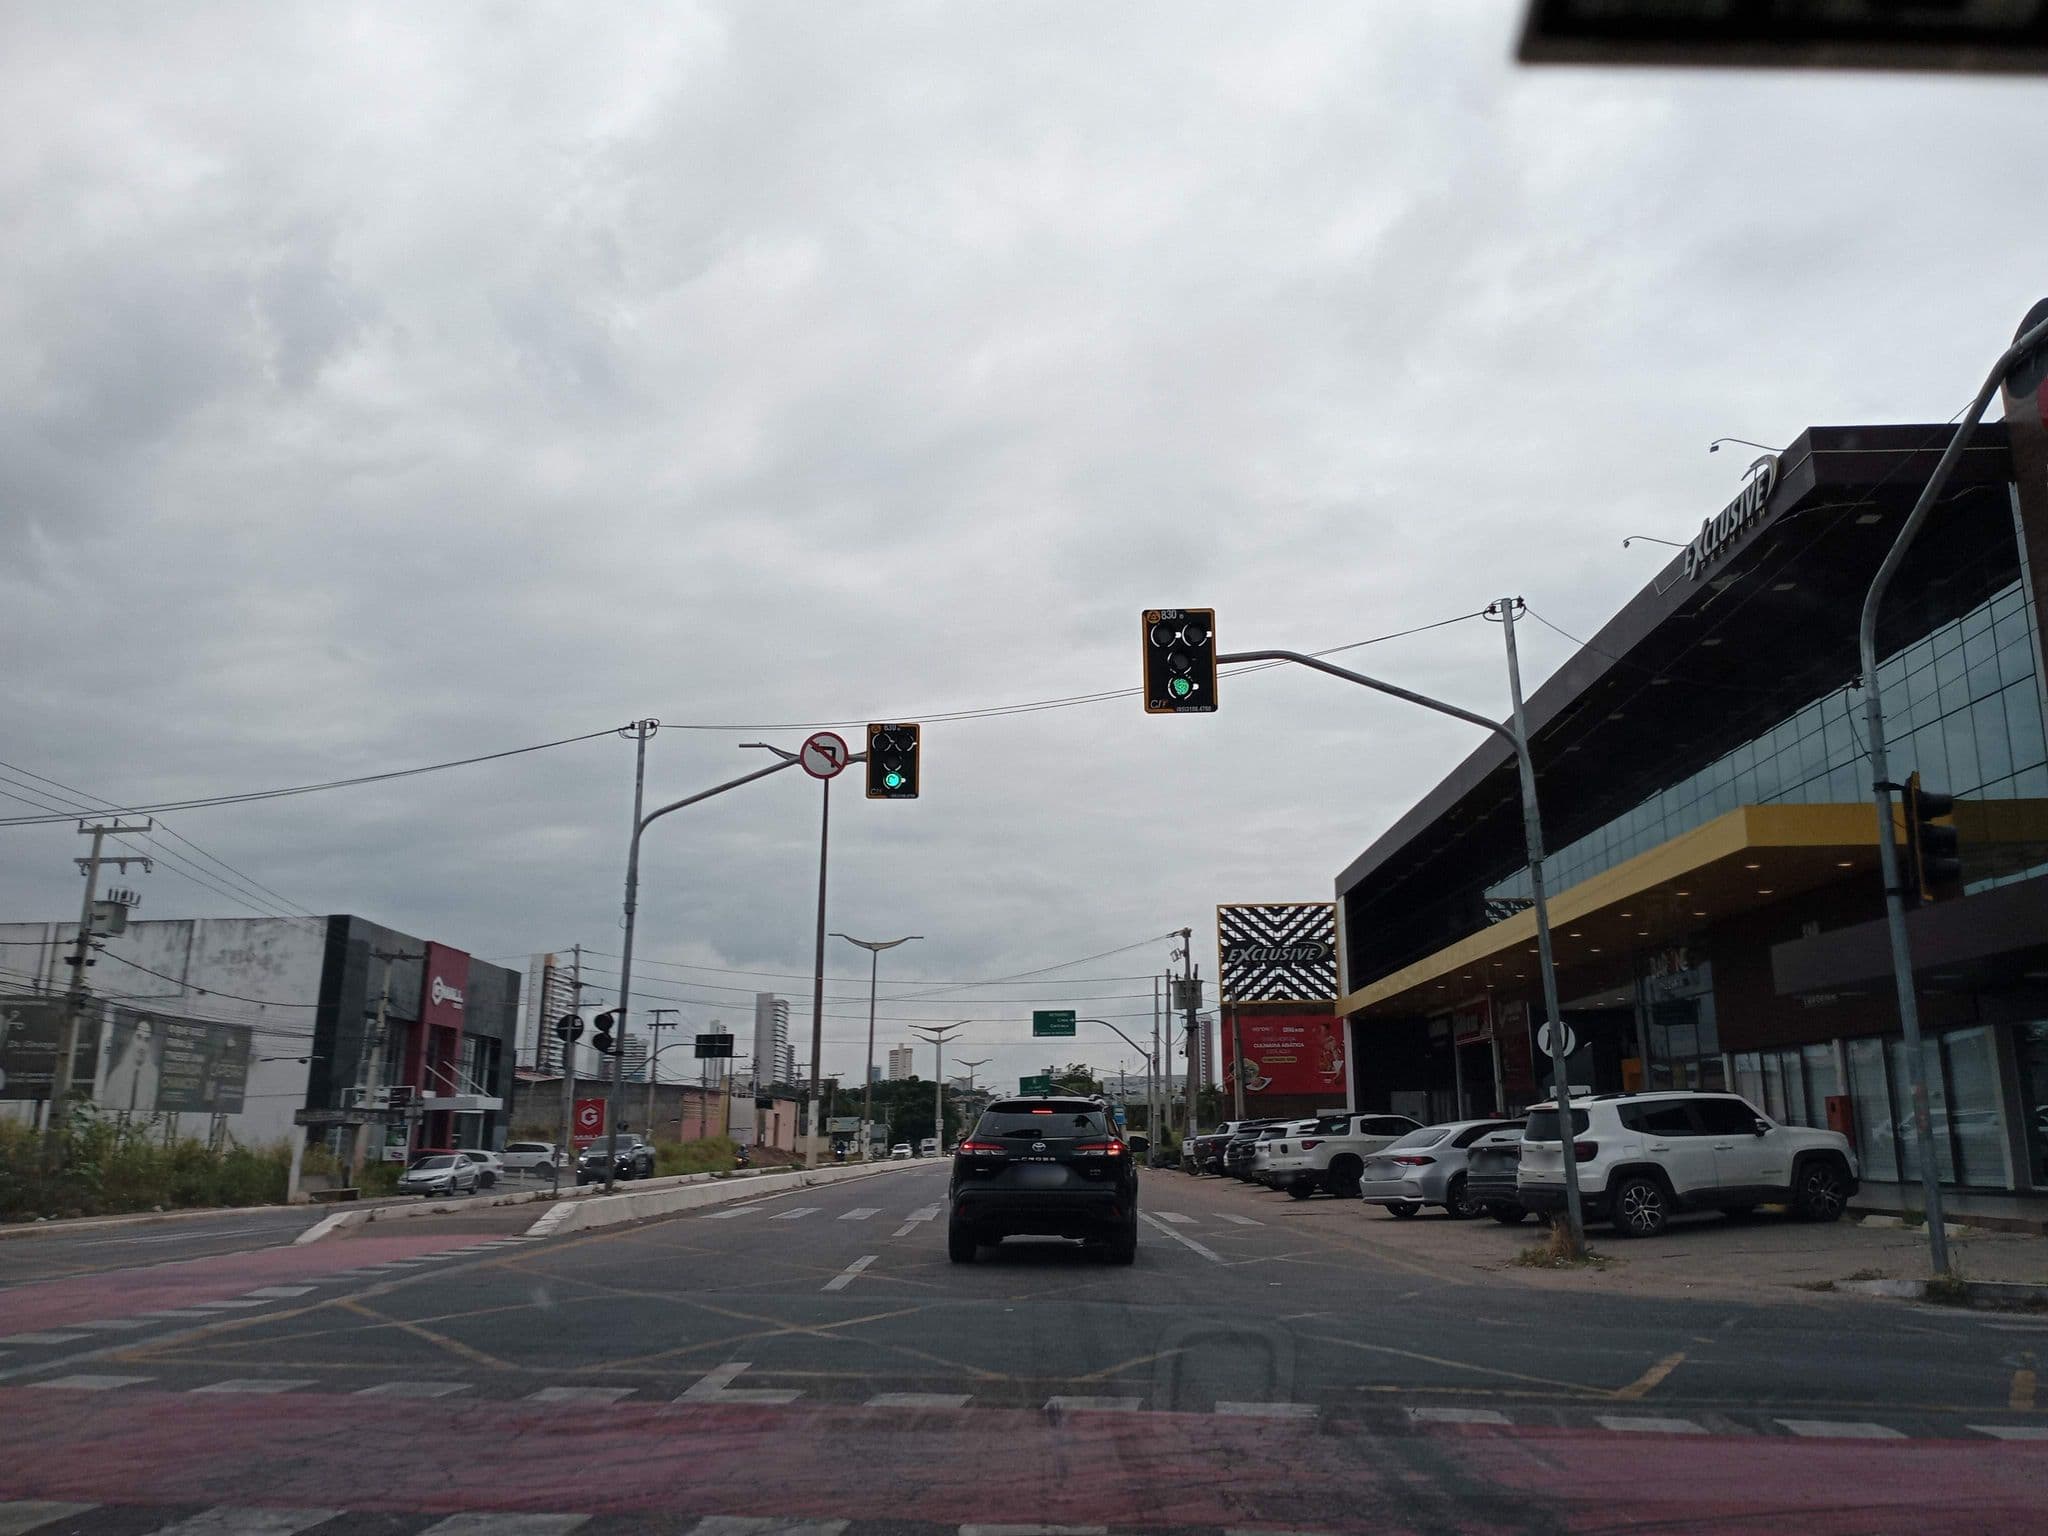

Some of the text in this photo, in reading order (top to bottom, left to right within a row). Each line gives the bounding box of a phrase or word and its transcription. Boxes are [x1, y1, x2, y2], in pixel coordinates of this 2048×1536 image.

[1684, 470, 1767, 580] EXCLUSIVE
[1701, 508, 1766, 571] PREMIUM
[1227, 944, 1318, 966] EXCLUSIVE
